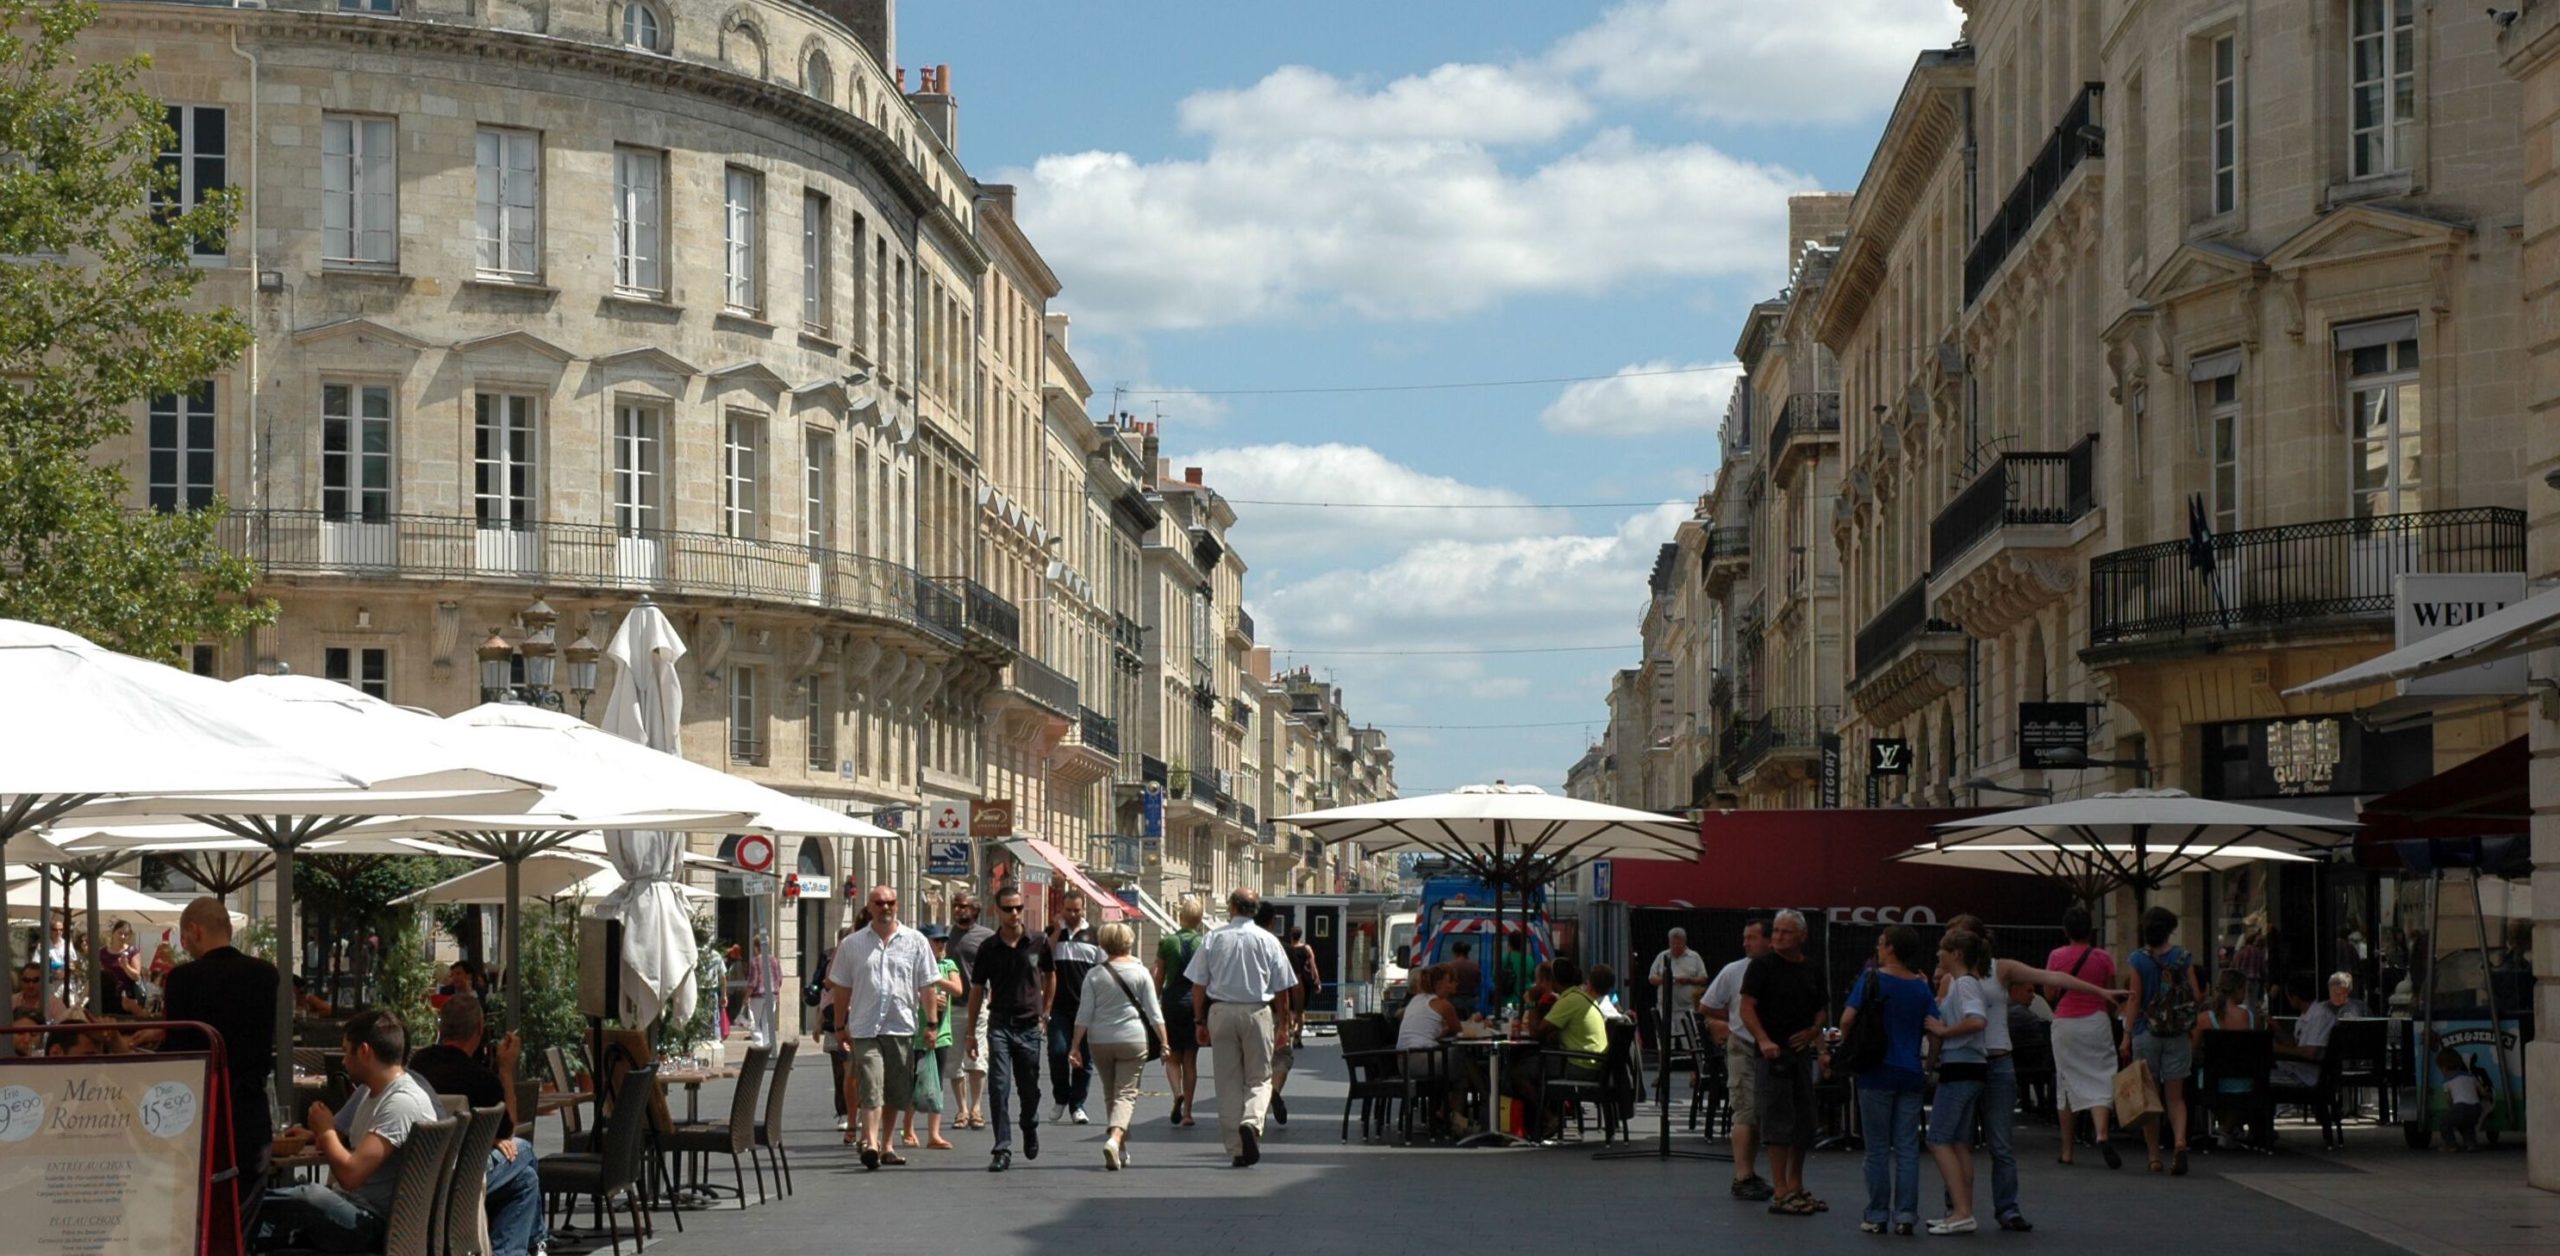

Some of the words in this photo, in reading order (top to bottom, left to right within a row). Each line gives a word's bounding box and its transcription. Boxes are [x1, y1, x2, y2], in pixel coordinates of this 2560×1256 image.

[2273, 761, 2333, 784] QUINZE
[1797, 904, 1937, 924] ESSO
[62, 1078, 124, 1102] Menu
[50, 1105, 131, 1129] Romain
